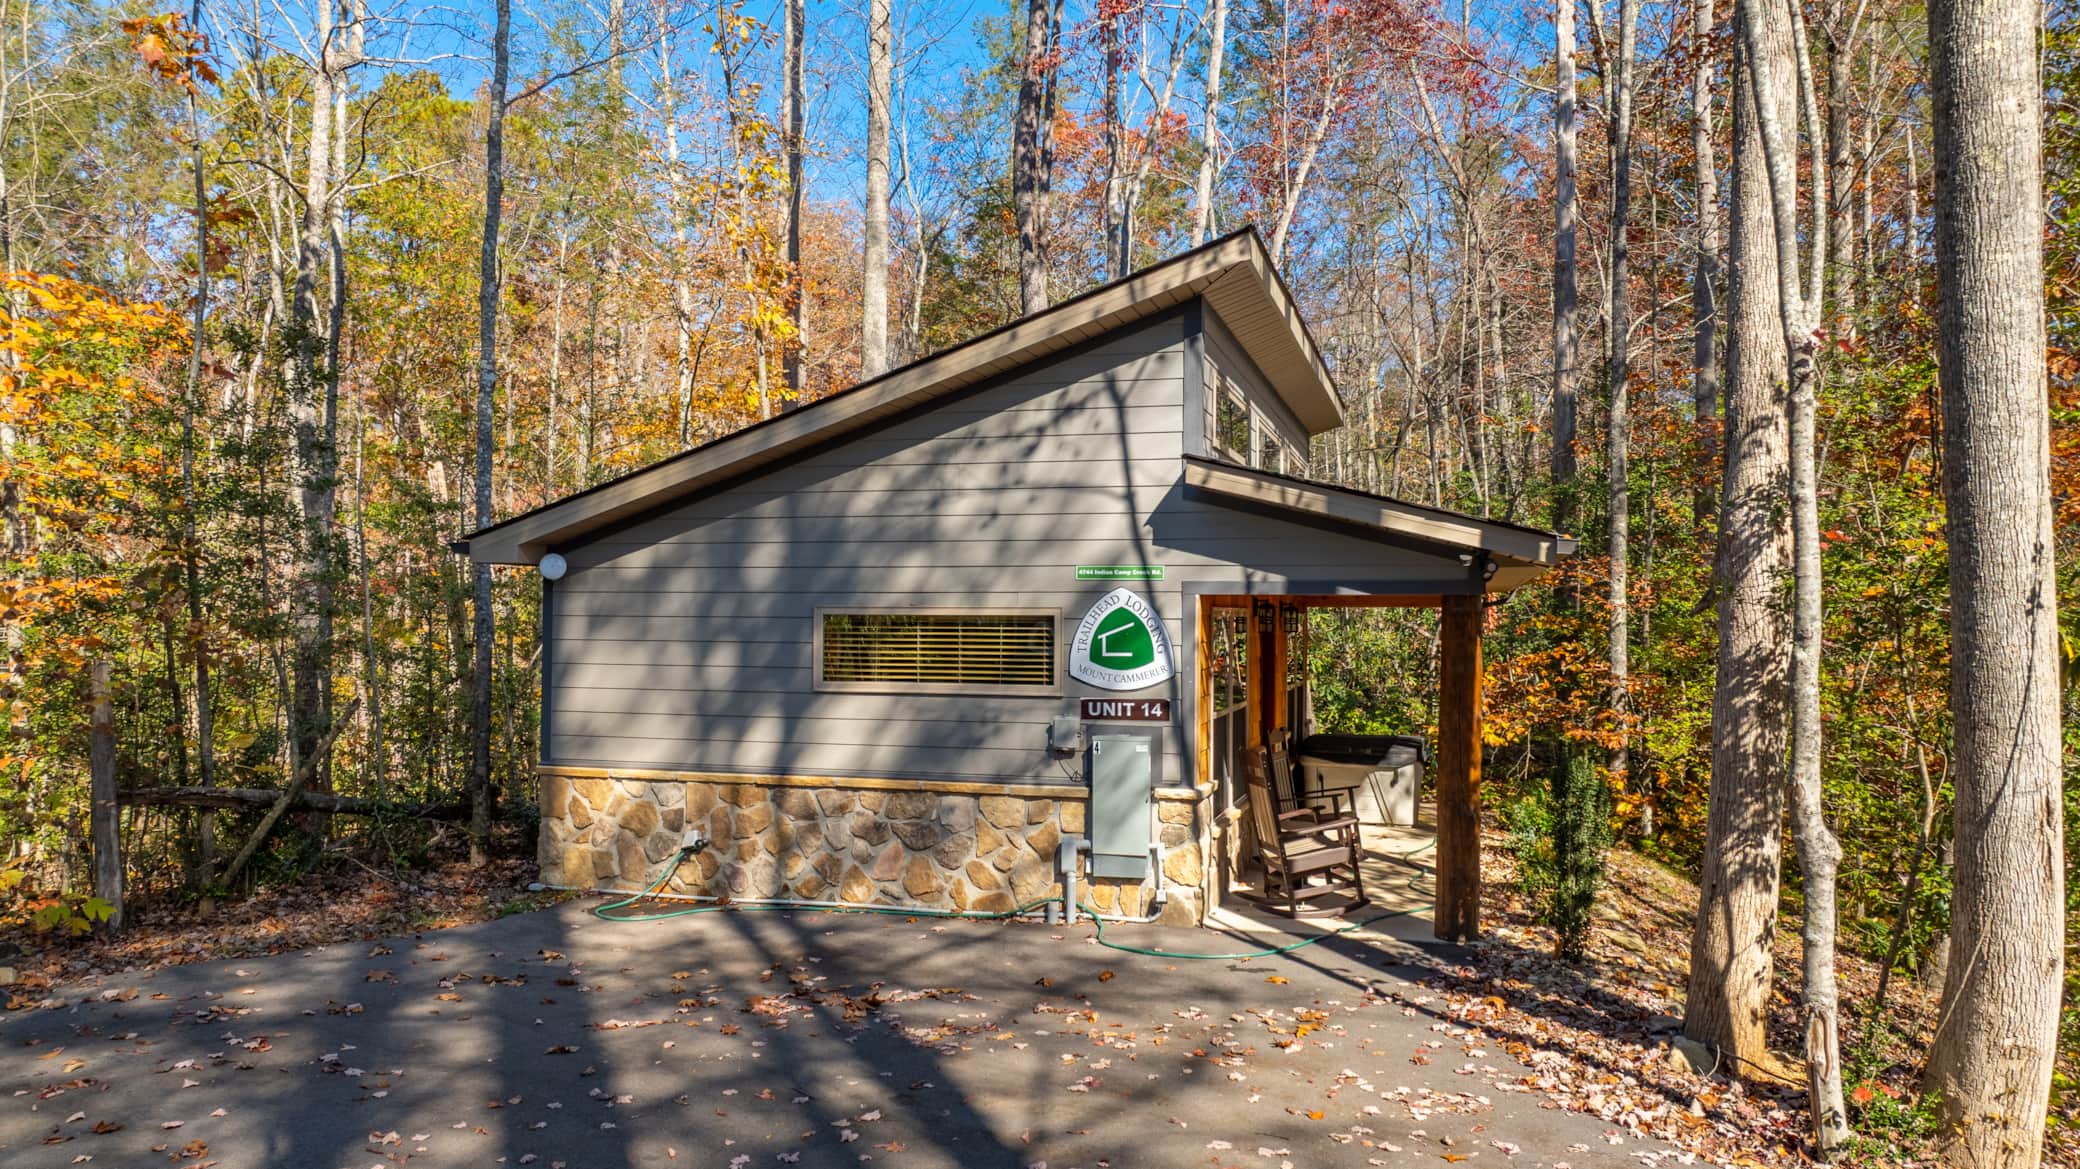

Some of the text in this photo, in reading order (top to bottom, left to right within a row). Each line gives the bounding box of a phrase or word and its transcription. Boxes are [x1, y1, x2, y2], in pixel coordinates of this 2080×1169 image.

[1077, 594, 1164, 654] TRAILHEAD LODGING
[1077, 663, 1169, 683] MOUNT CAMMERER
[1088, 702, 1163, 717] UNIT 14
[1094, 741, 1099, 753] 4
